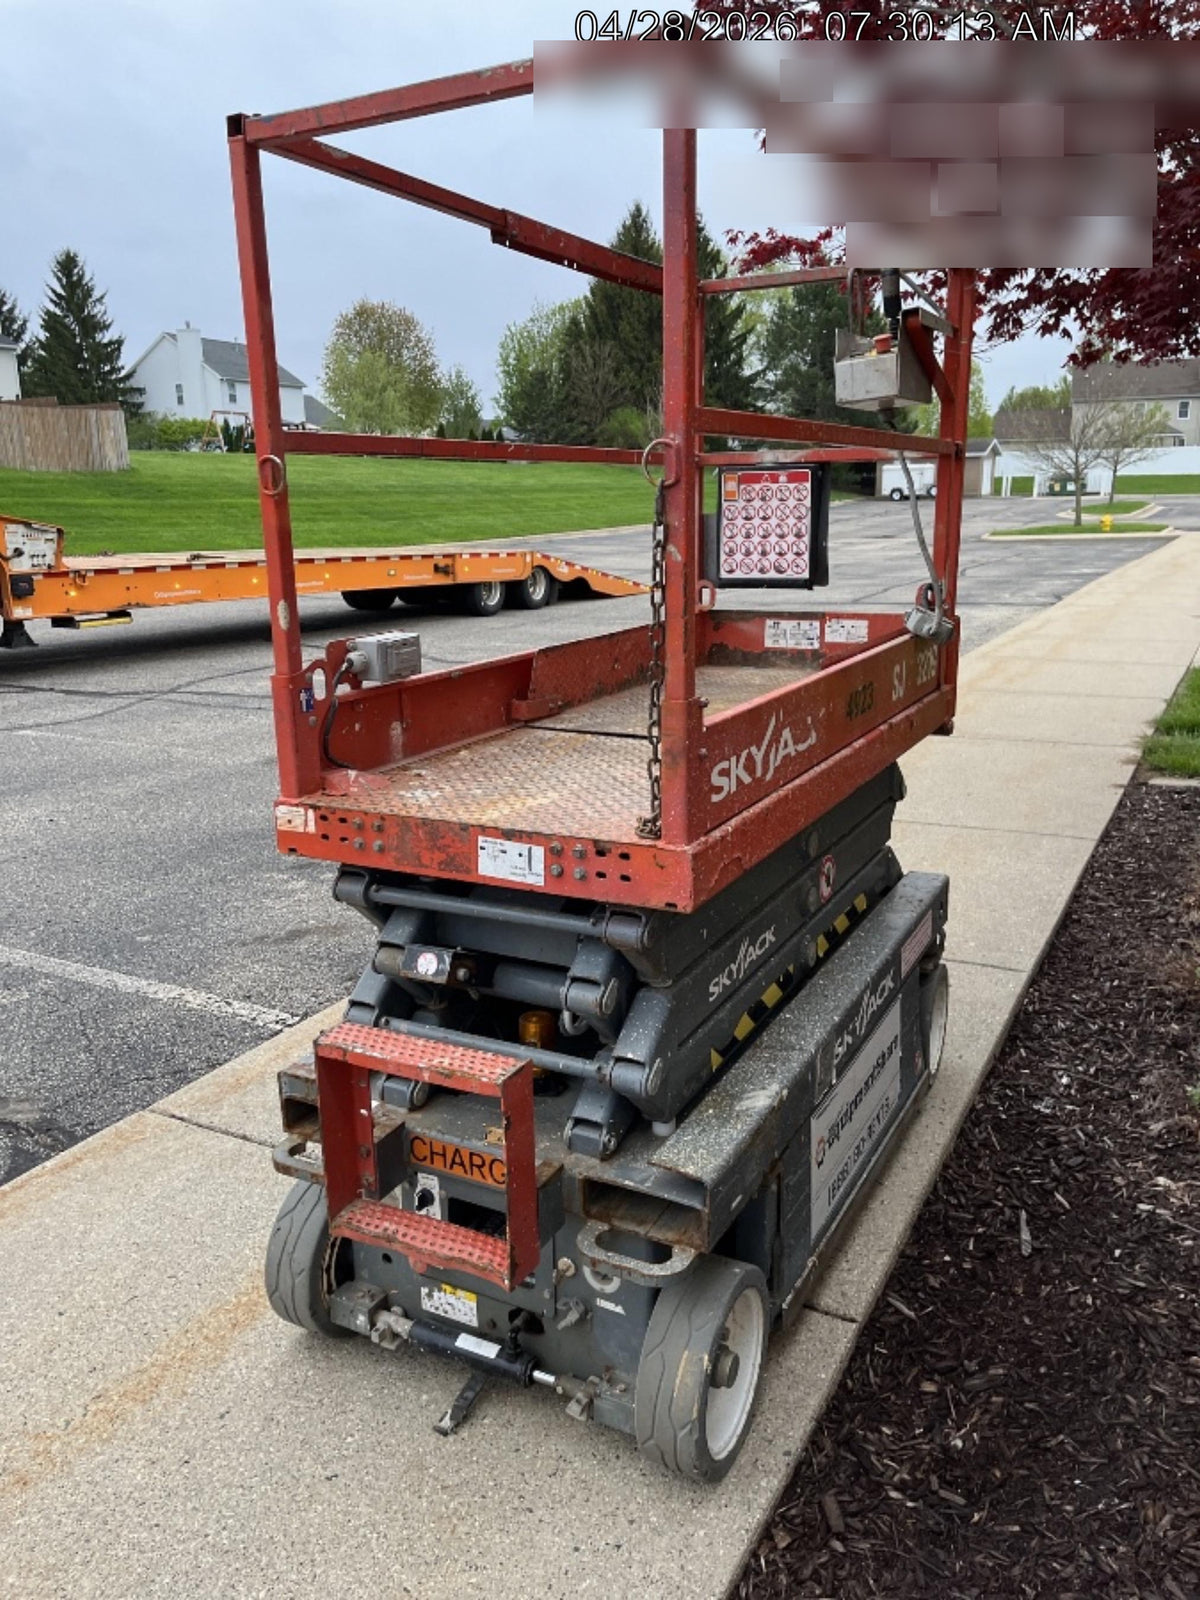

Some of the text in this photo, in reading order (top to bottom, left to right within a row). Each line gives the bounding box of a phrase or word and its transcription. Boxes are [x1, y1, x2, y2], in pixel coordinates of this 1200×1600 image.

[892, 660, 906, 702] SJ
[711, 707, 826, 803] SKYJA
[708, 925, 777, 1002] SKYJACK
